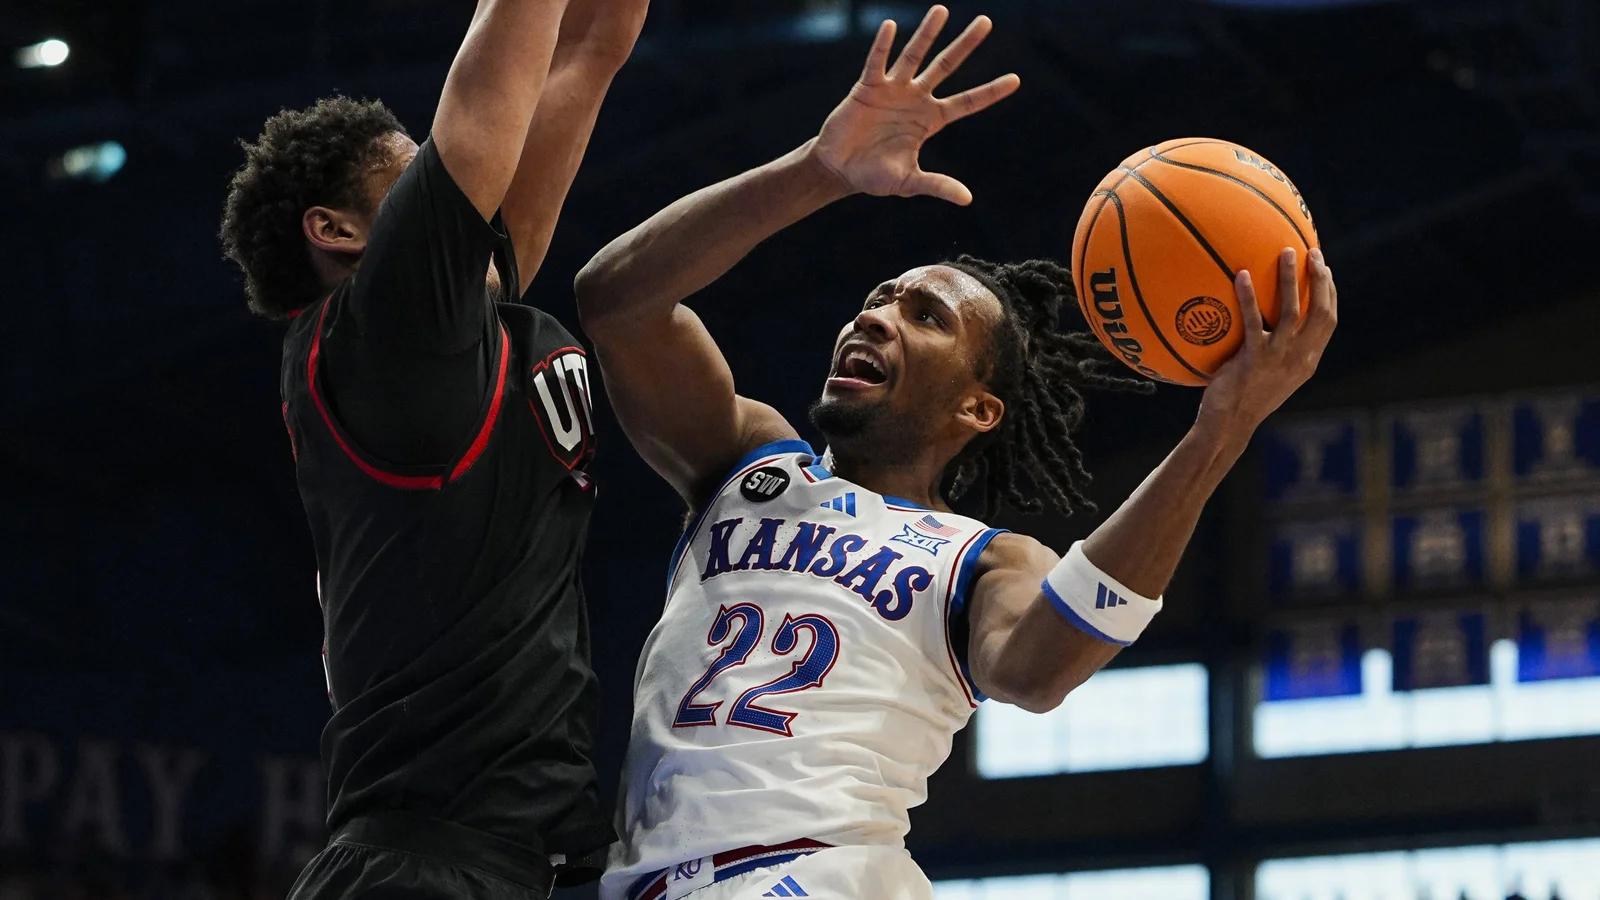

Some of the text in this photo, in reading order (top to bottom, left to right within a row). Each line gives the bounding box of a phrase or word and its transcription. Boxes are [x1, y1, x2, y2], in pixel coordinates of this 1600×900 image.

[744, 470, 787, 497] SW
[699, 517, 935, 621] KANSAS
[671, 601, 841, 738] 22
[0, 729, 210, 860] PAY
[673, 858, 702, 881] KU
